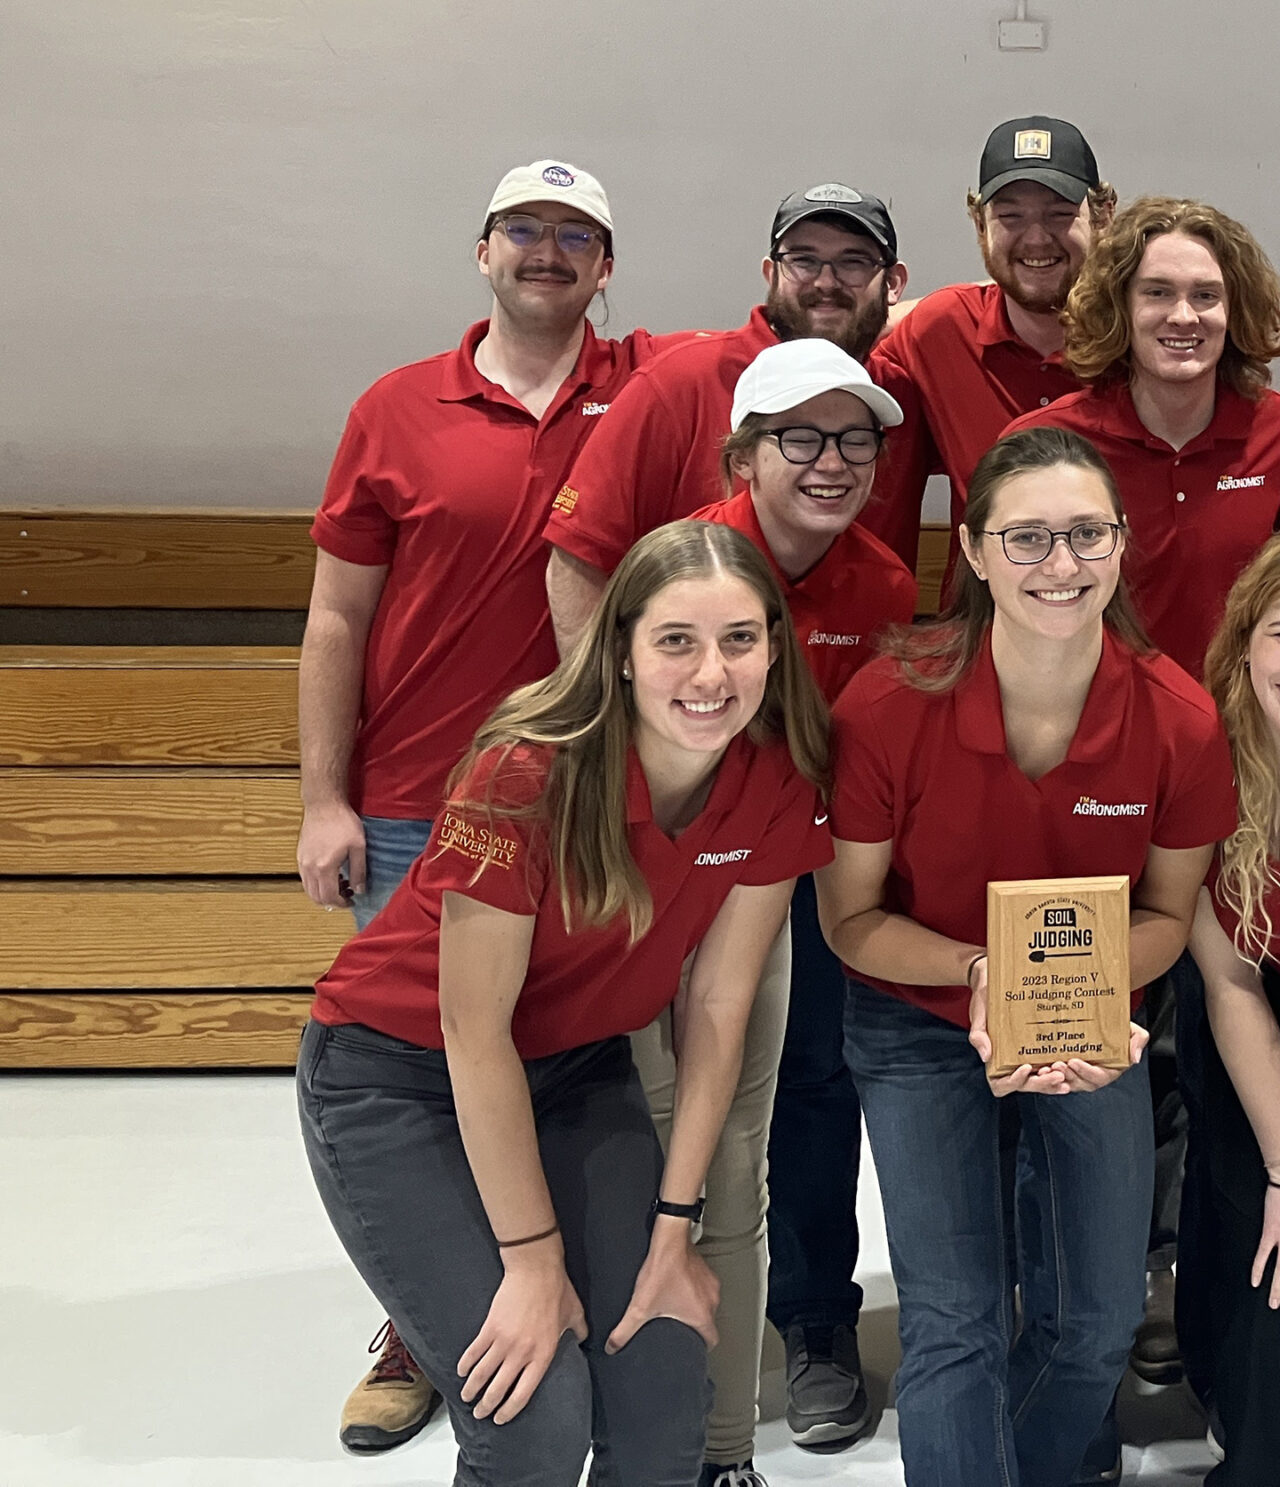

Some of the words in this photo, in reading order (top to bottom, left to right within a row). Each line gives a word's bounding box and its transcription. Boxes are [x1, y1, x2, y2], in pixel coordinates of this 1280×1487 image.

[1216, 475, 1266, 490] AGRONOMIST
[1073, 803, 1148, 816] AGRONOMIST
[444, 813, 475, 838] IOWA
[694, 850, 752, 865] ONOMIST
[1047, 910, 1073, 924] SOIL
[1028, 929, 1092, 949] JUDGING
[1022, 975, 1047, 986] 2023
[1051, 974, 1087, 986] Region
[1090, 972, 1098, 983] V
[1005, 991, 1025, 1001] Soil
[1028, 989, 1071, 1001] Judging
[1074, 987, 1115, 997] Contest
[1036, 1002, 1069, 1012] Sturgis,
[1071, 1001, 1084, 1009] SD
[1036, 1032, 1053, 1041] 3rd
[1057, 1031, 1085, 1040] Place
[1018, 1045, 1057, 1055] Jumble
[1060, 1043, 1102, 1053] Judging
